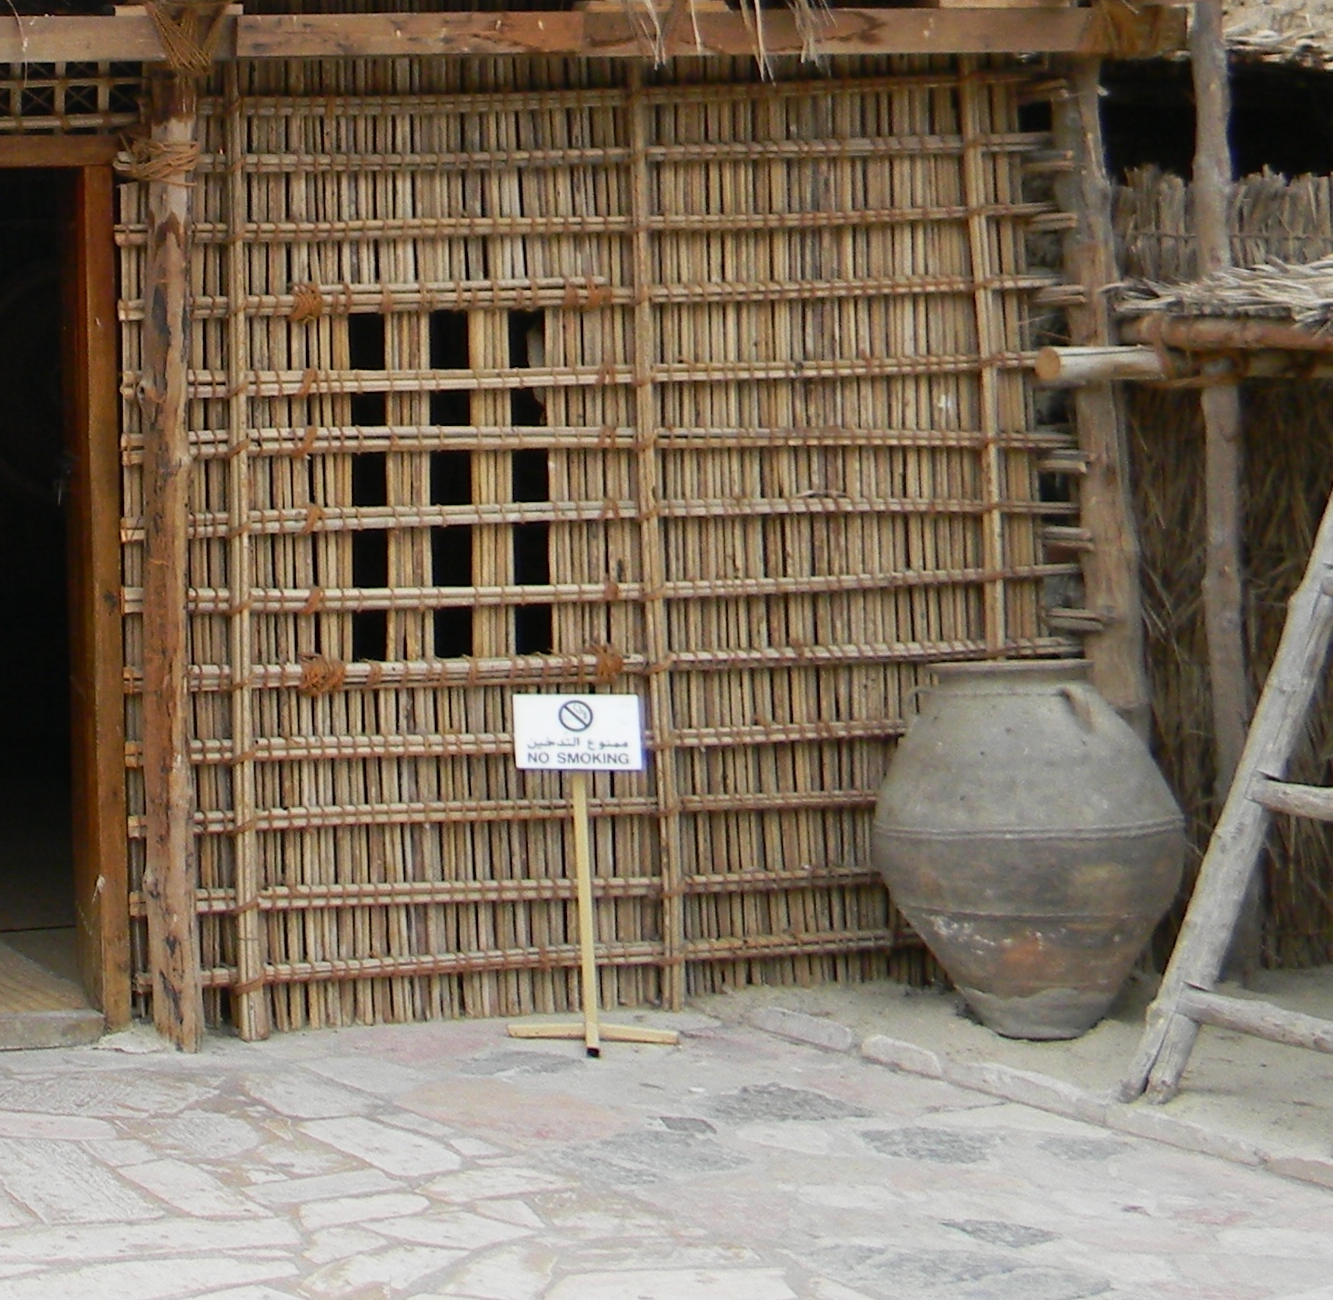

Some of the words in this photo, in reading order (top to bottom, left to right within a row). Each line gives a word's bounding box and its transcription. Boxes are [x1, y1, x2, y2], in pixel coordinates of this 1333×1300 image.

[527, 736, 580, 749] التدخين
[587, 738, 629, 751] ممنوع
[527, 752, 550, 765] NO
[556, 752, 630, 765] SMOKING
